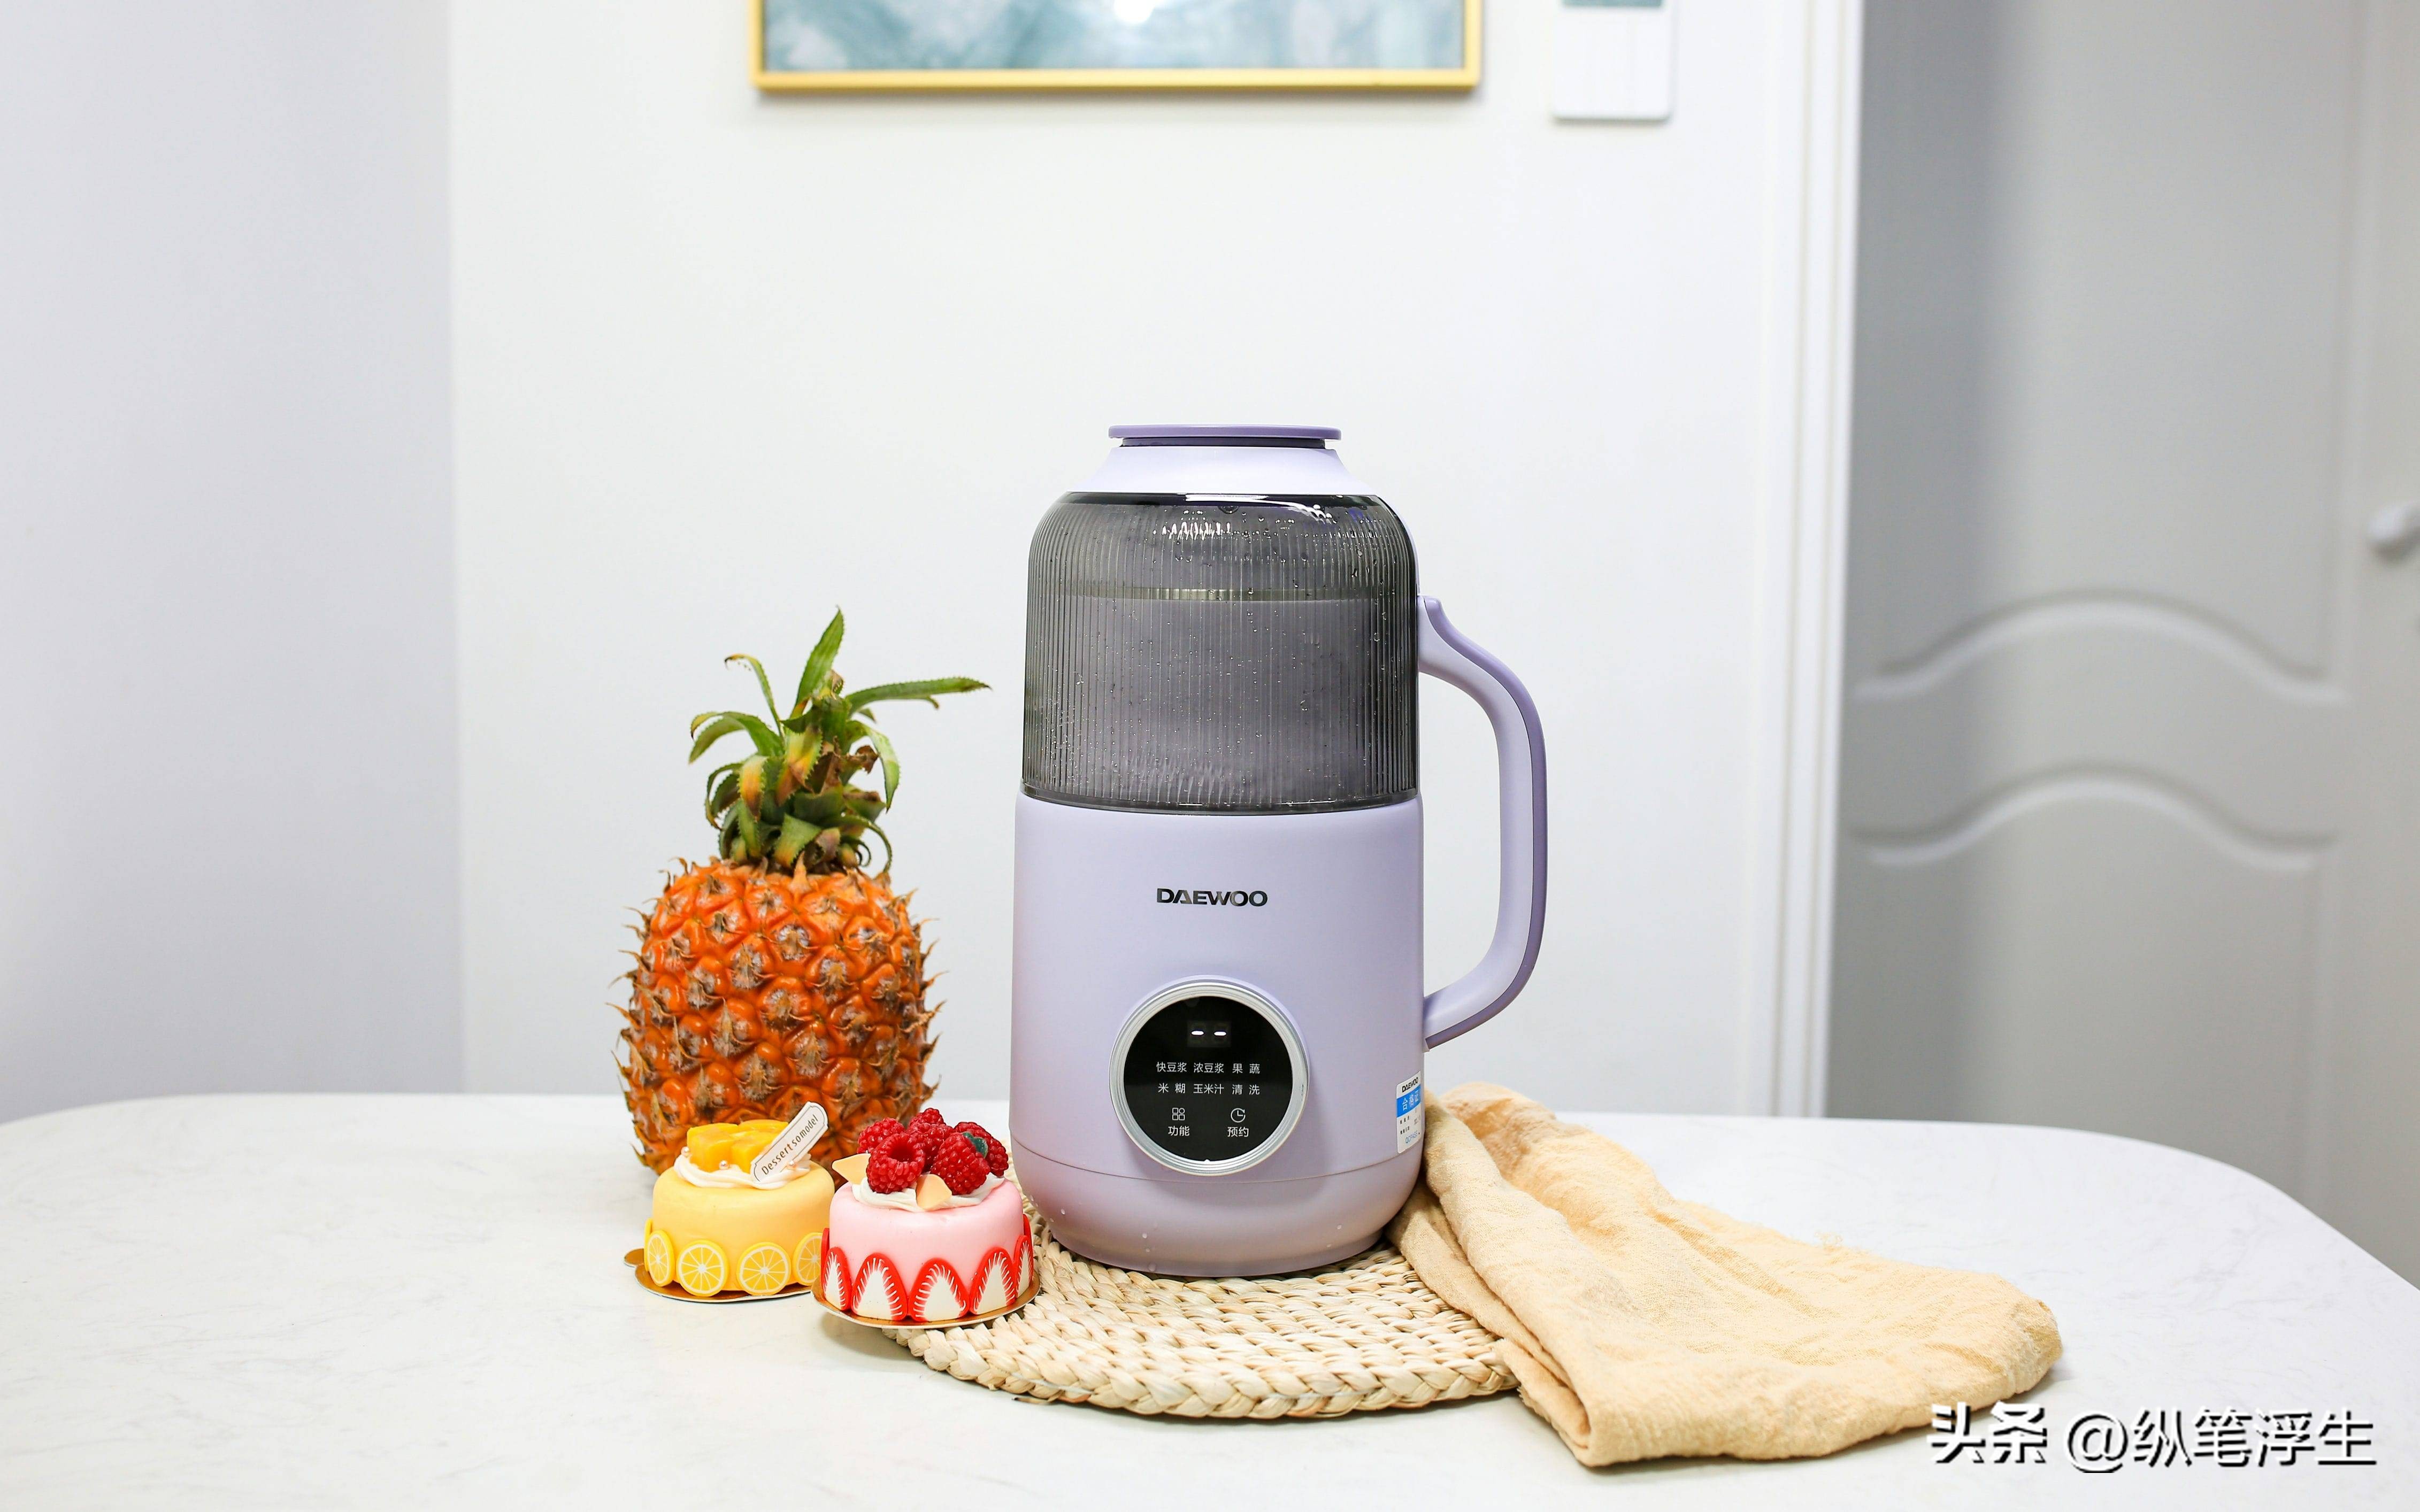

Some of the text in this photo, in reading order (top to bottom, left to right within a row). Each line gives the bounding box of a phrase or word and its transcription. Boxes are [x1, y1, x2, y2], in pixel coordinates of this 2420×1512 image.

[1156, 888, 1268, 907] DAEWOO
[1156, 1061, 1187, 1073] 快豆浆
[1193, 1062, 1225, 1074] 浓豆浆
[1193, 1083, 1225, 1095] 玉米汁
[1402, 1077, 1418, 1092] DAEWOO
[1167, 1125, 1190, 1136] 功能
[1227, 1127, 1249, 1137] 预约
[761, 1143, 794, 1175] Dessert
